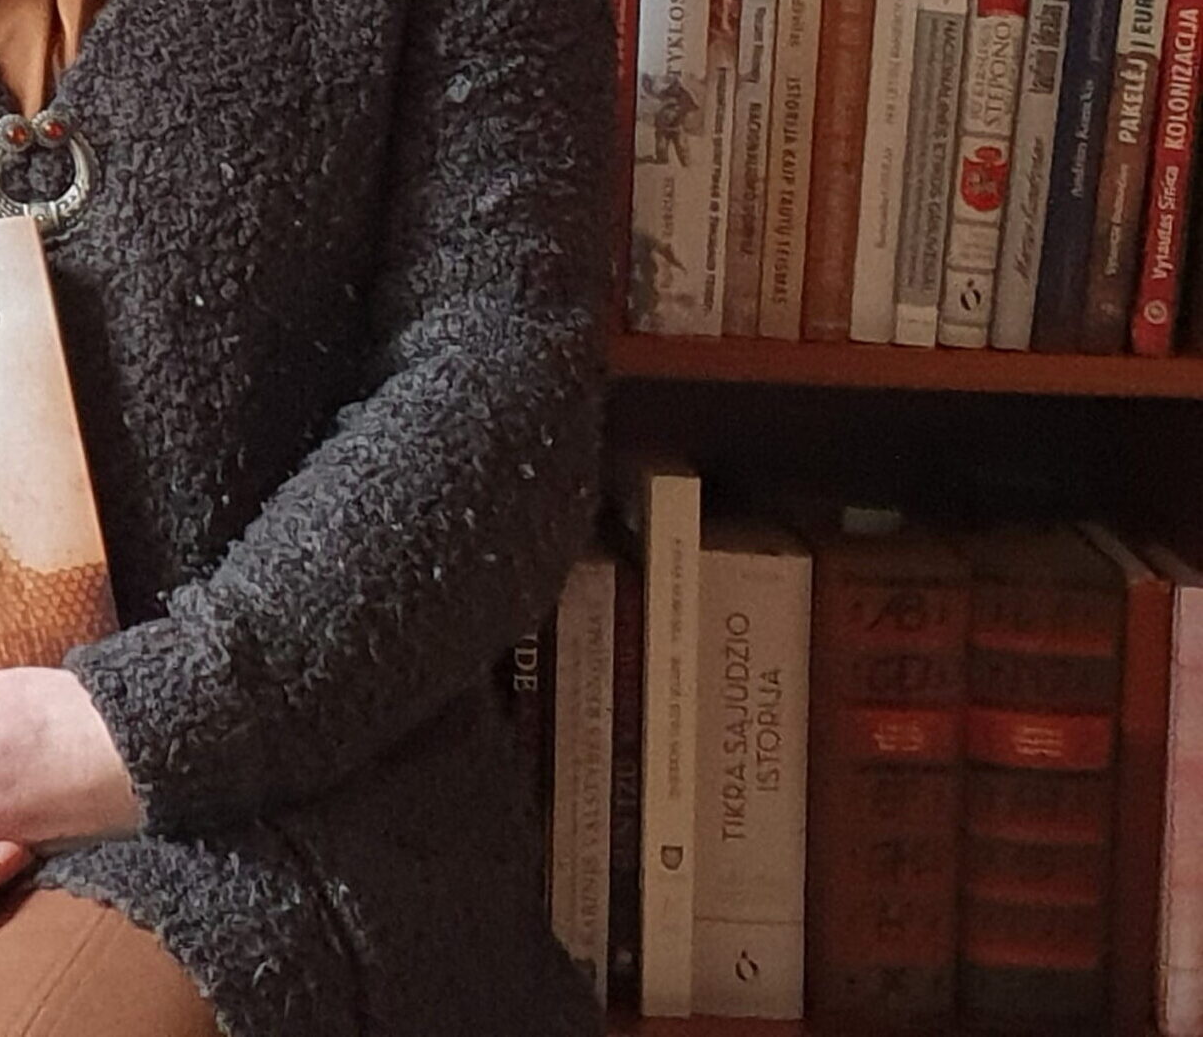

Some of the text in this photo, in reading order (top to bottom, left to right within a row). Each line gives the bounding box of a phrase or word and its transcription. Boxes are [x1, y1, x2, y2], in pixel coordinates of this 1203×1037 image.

[1161, 8, 1199, 150] KOLONIZACIJA
[756, 668, 783, 793] ISTORIJA
[720, 763, 747, 843] TIKRA
